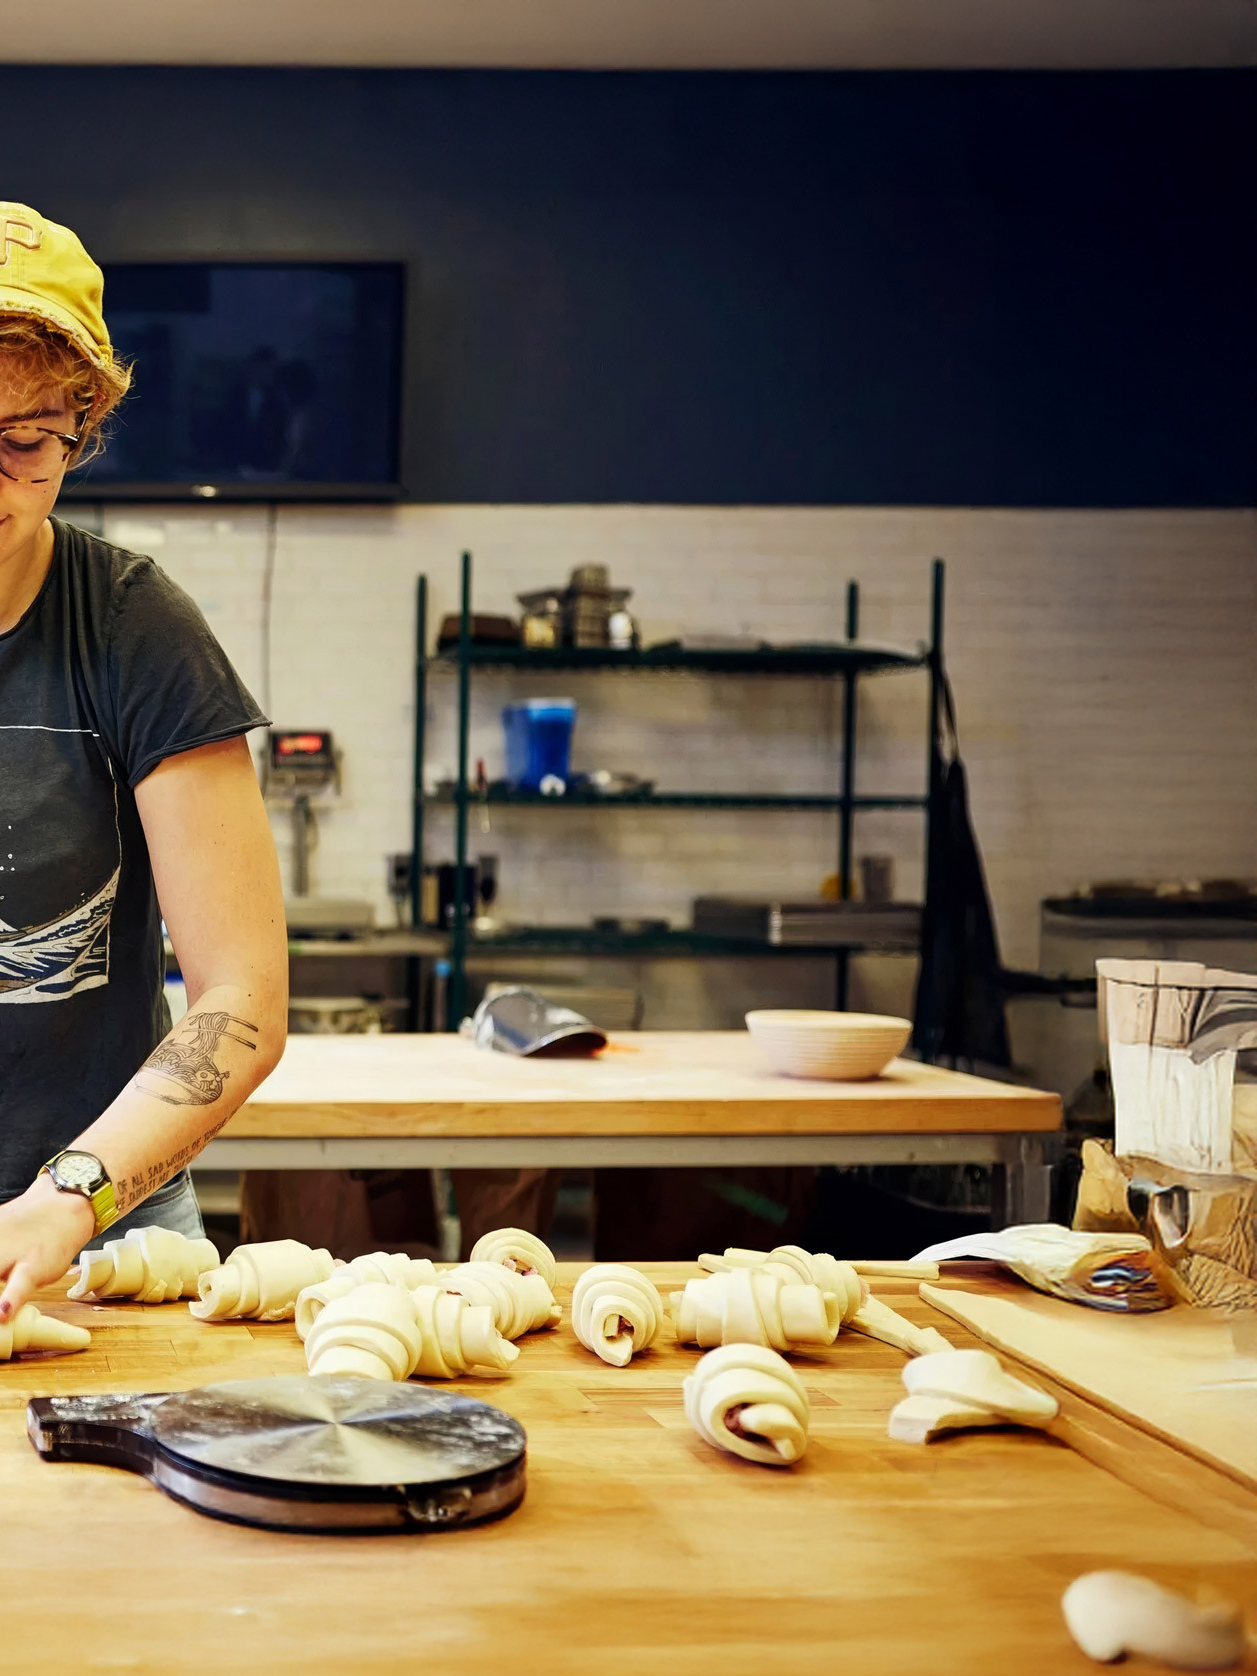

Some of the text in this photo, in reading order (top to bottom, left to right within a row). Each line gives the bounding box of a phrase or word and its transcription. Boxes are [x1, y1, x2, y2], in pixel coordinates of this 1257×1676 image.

[117, 1179, 127, 1195] OF
[131, 1172, 144, 1189] ALL
[147, 1162, 164, 1179] SAD
[165, 1145, 190, 1168] WORDS
[191, 1136, 202, 1151] OF
